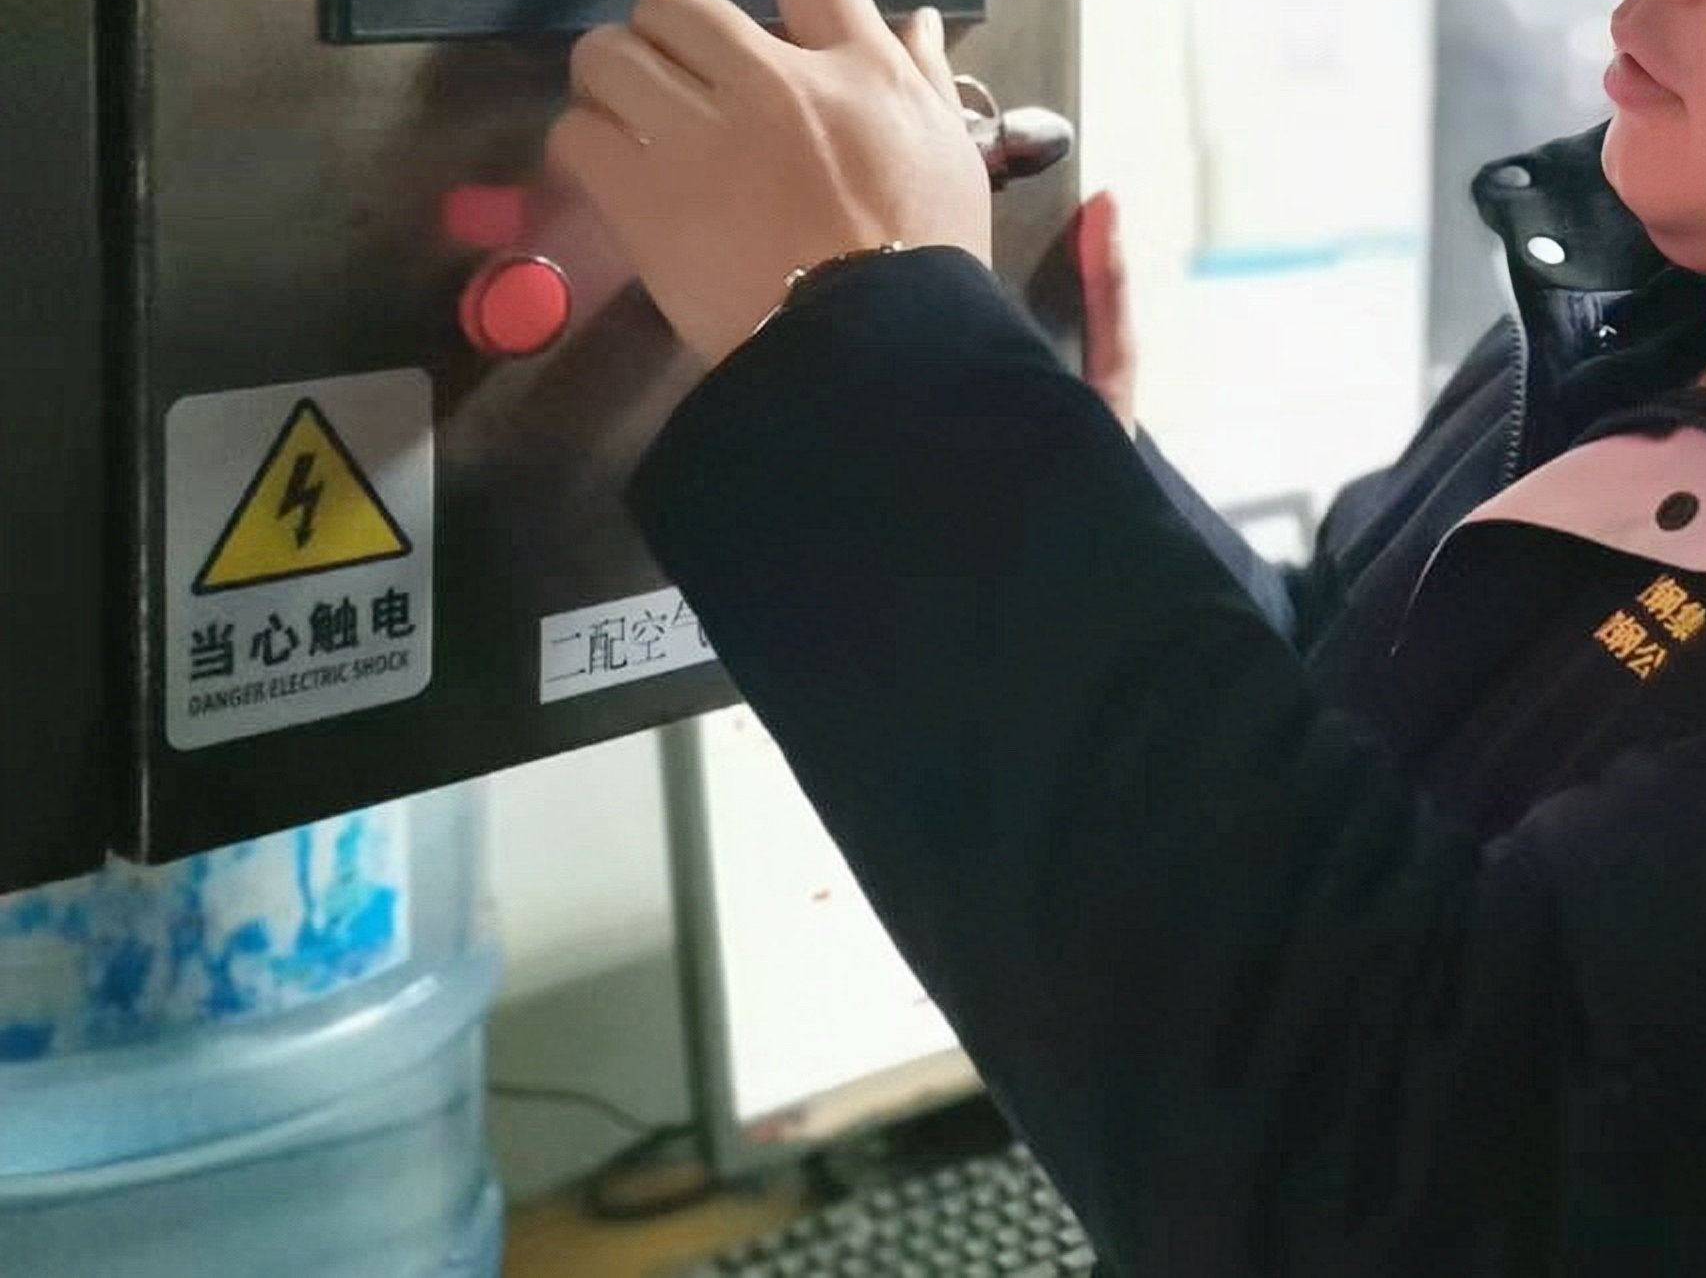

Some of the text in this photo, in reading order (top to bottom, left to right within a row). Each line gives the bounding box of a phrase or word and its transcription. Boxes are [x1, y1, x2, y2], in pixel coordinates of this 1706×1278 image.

[189, 586, 417, 681] 当心触电
[188, 649, 410, 717] DANGER ELECTRIC SHOCK
